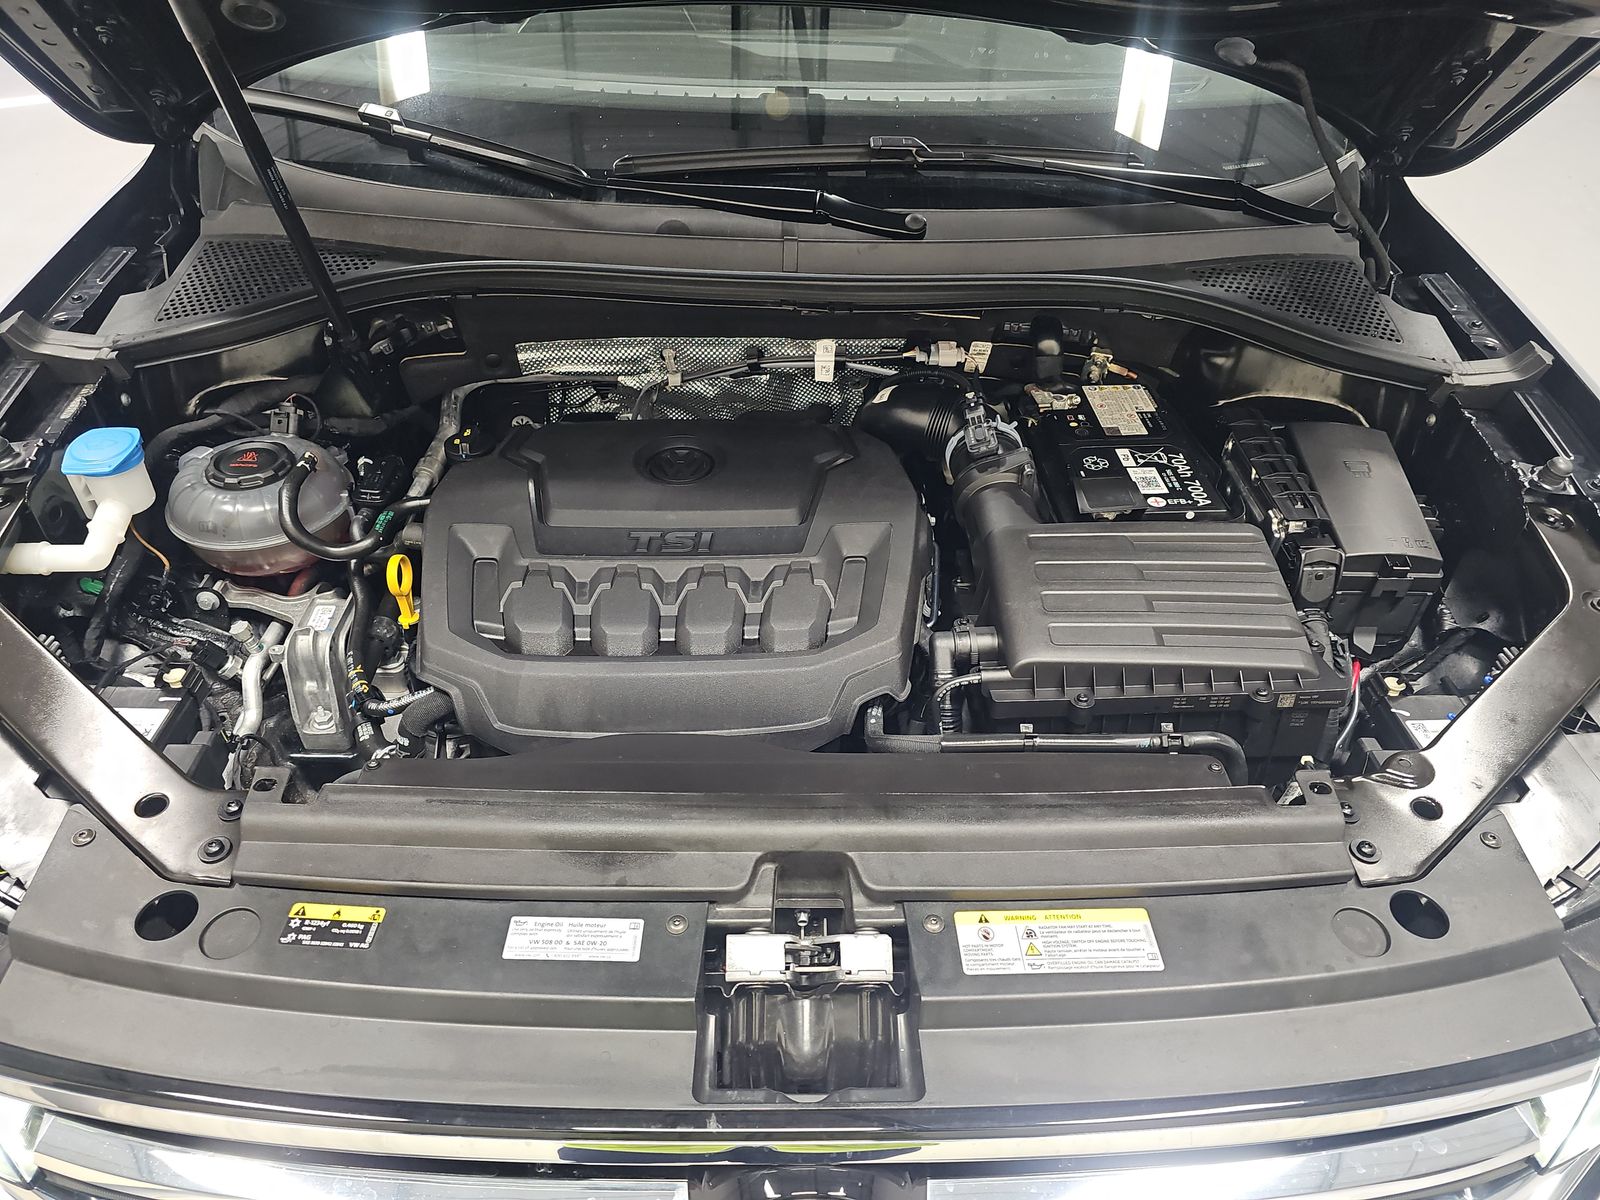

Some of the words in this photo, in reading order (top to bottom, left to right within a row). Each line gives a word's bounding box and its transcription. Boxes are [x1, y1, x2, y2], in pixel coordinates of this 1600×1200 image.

[1120, 454, 1130, 462] Pb
[1168, 453, 1194, 478] 70Ah
[1184, 480, 1212, 506] 700A
[629, 531, 714, 553] TSI
